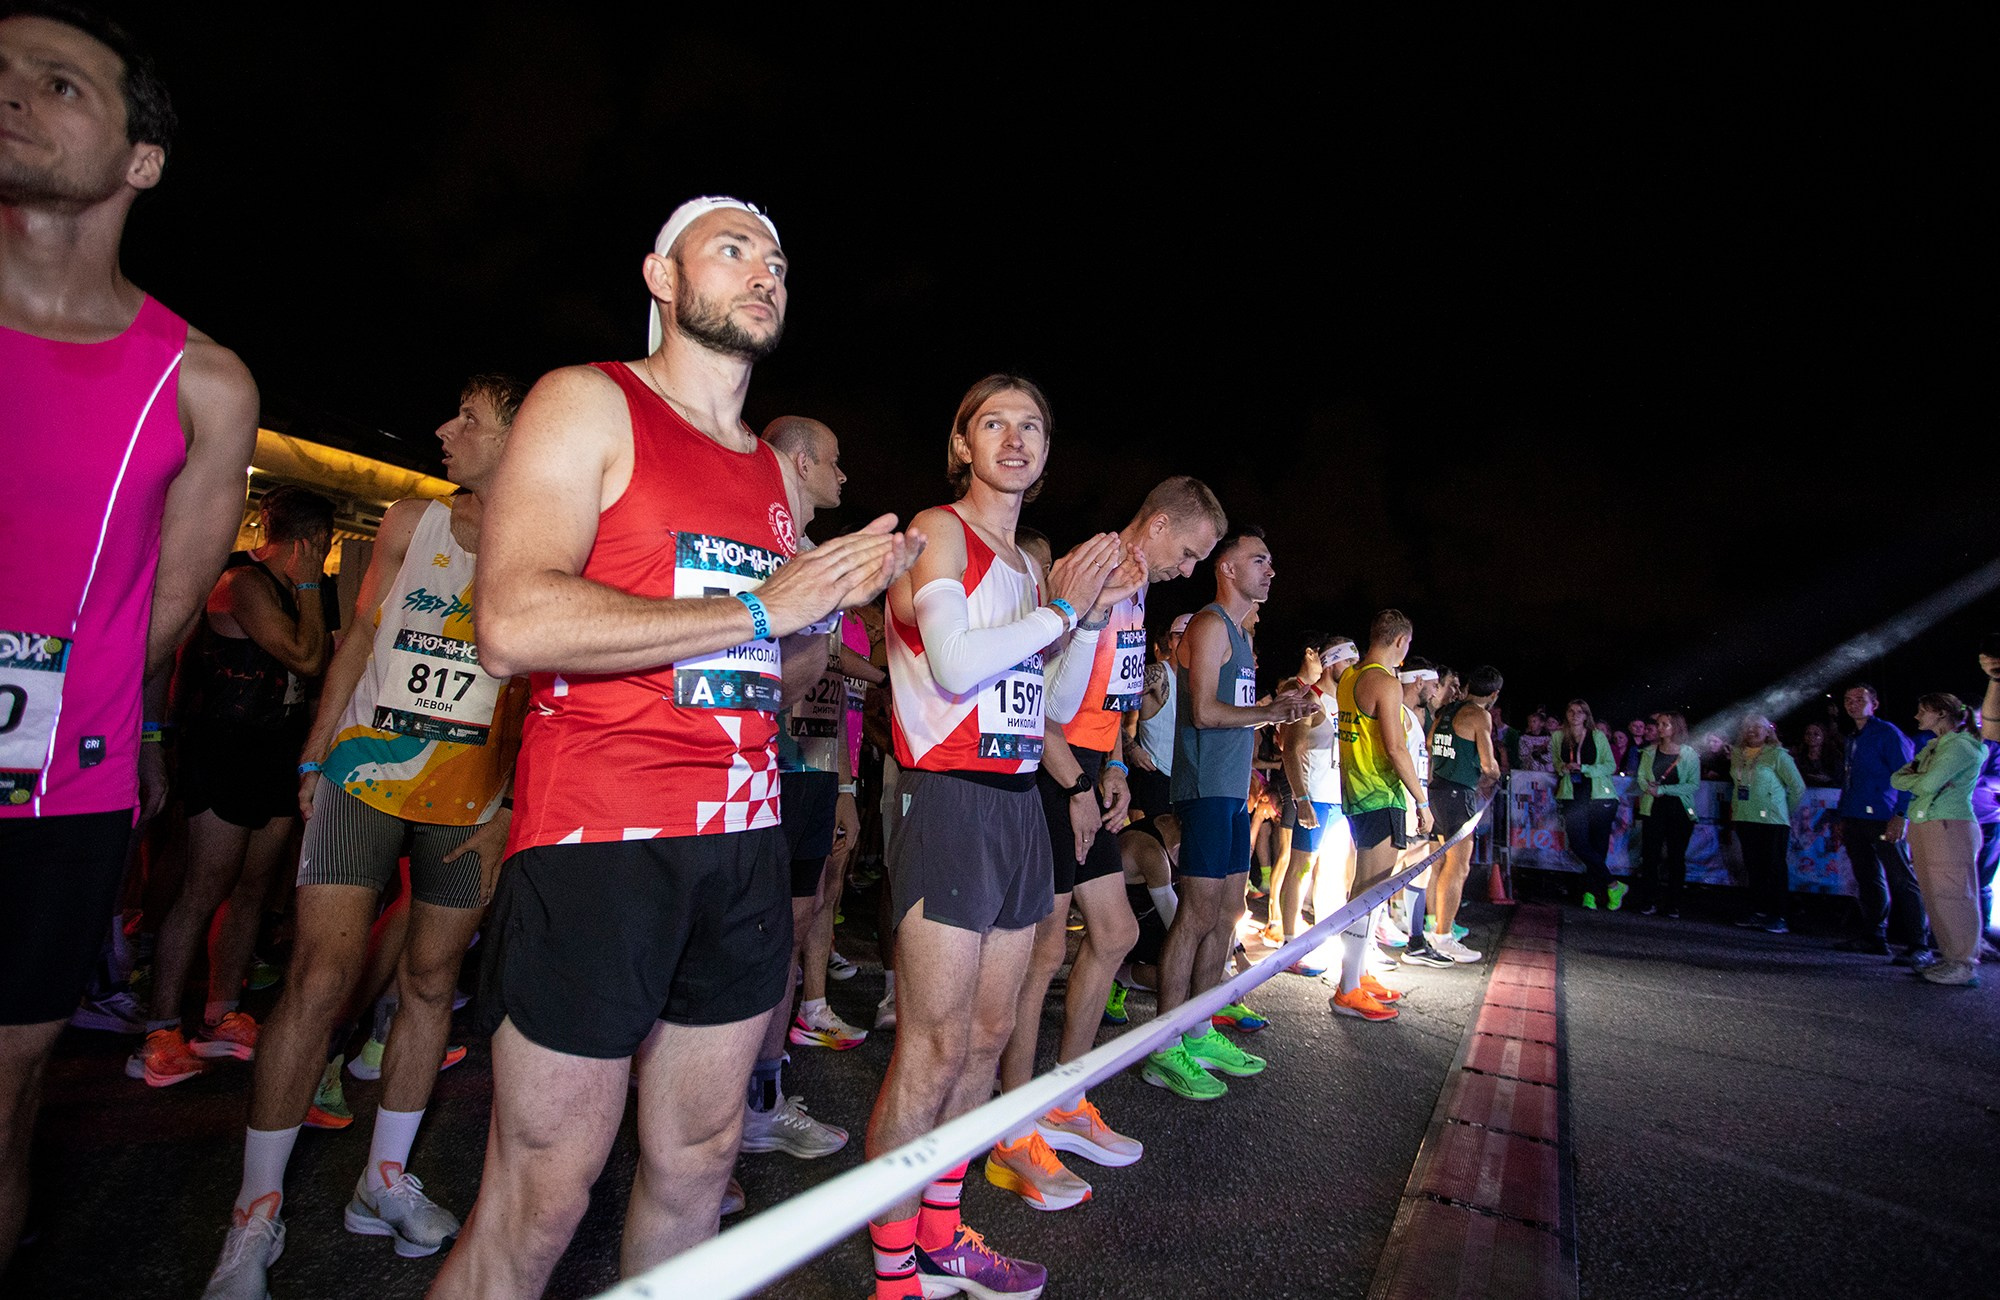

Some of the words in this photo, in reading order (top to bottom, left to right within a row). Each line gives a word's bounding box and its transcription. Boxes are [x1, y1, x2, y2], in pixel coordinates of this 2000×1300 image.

[748, 603, 768, 635] 5830
[727, 646, 779, 665] НИКОЛАЙ
[407, 663, 476, 702] 817
[690, 677, 715, 704] A
[414, 697, 453, 713] ЛЕВОН
[994, 679, 1043, 717] 1597
[382, 711, 394, 729] A
[1007, 717, 1037, 729] НИКОЛАЙ
[987, 738, 1001, 757] A
